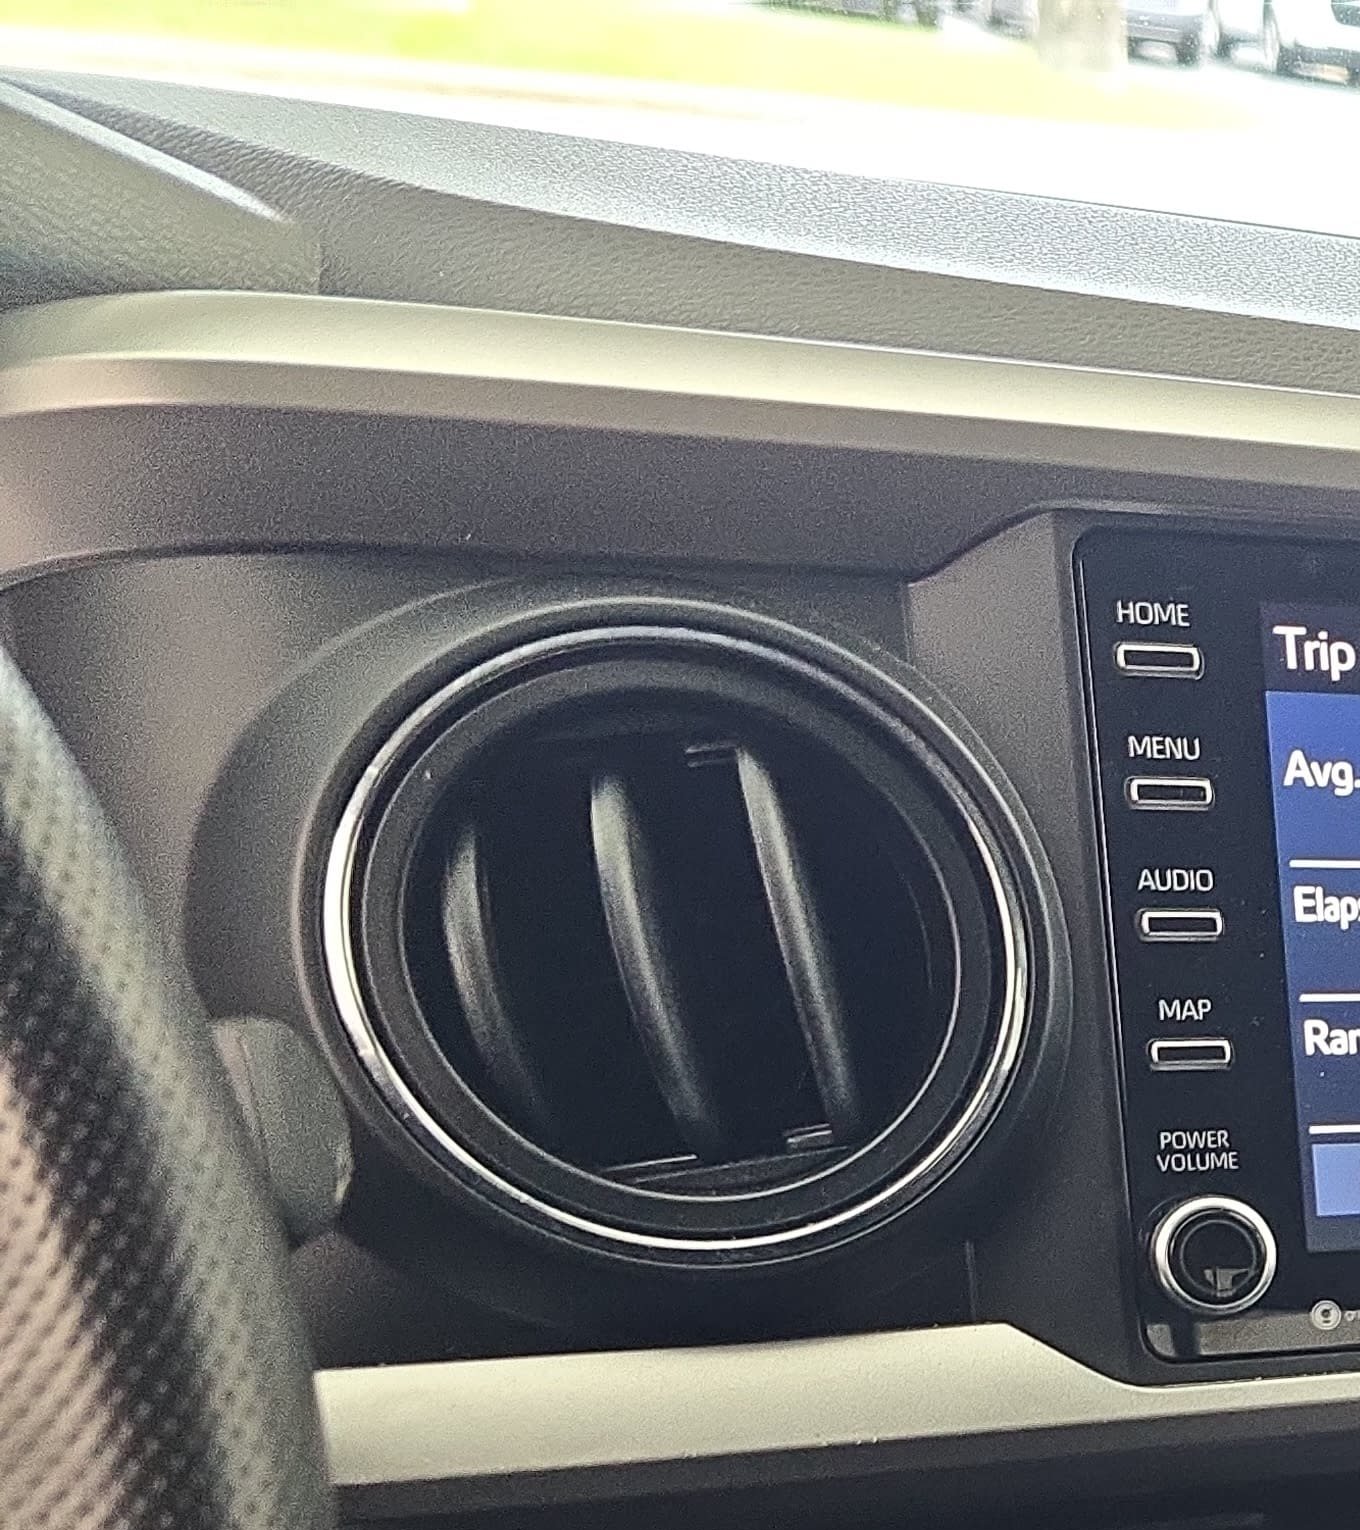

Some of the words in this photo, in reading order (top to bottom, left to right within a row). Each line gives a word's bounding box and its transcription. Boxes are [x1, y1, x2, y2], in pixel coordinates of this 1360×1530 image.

[1116, 600, 1190, 627] HOME
[1273, 625, 1357, 681] Trip
[1128, 736, 1201, 761] MENU
[1137, 868, 1213, 892] AUDIO
[1158, 999, 1211, 1020] MAP
[1160, 1130, 1229, 1149] POWER
[1156, 1151, 1239, 1172] VOLUME
